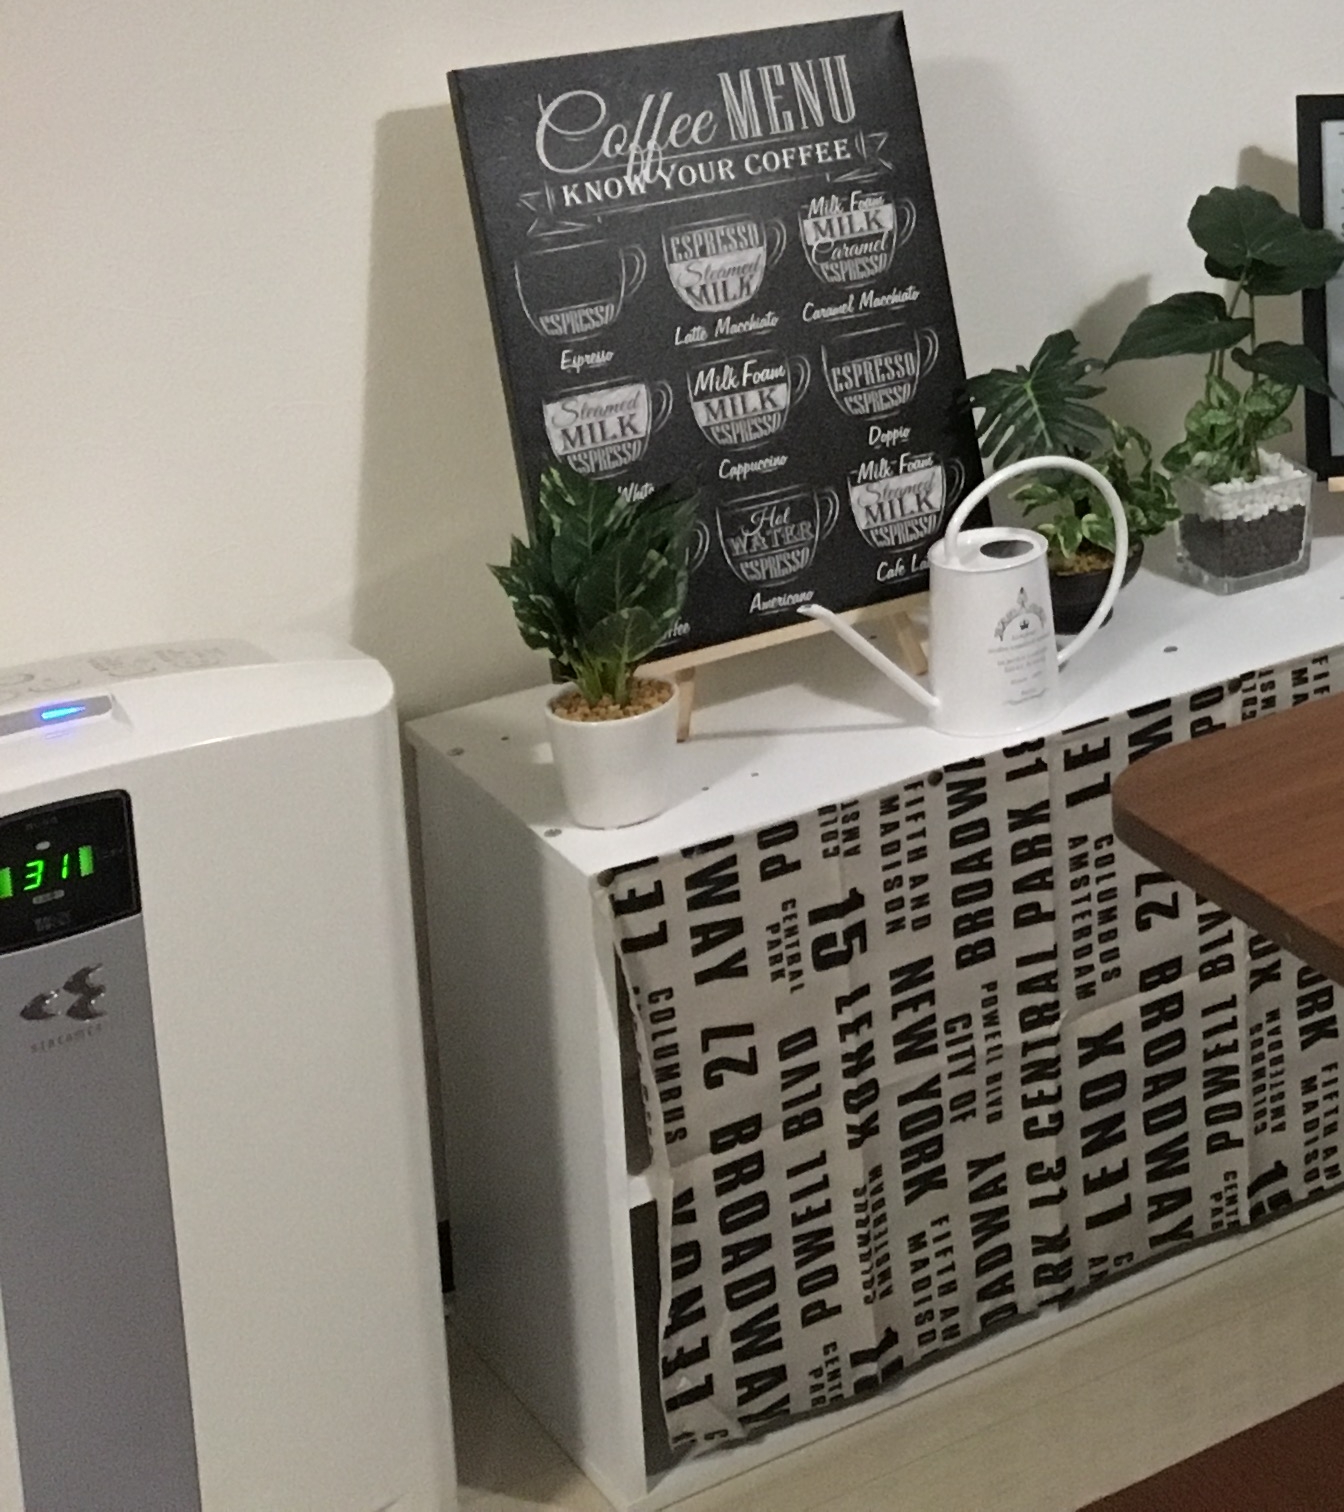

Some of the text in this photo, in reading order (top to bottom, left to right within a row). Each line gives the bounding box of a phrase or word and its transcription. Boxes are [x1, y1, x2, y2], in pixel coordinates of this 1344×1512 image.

[535, 54, 856, 182] Coffee MENU
[562, 138, 852, 207] KNOW YOUR COFFEE
[809, 194, 843, 218] Milk
[812, 209, 884, 239] MILK
[670, 222, 760, 262] ESPRESSO
[812, 230, 888, 265] Caramel
[820, 253, 888, 283] ESPRESSO
[539, 303, 614, 336] ESPRESSO
[802, 285, 920, 322] Caramel Macchiato
[675, 311, 779, 346] Latte Macchiato
[561, 349, 614, 373] Espresso
[694, 359, 786, 396] Milk Foam
[831, 351, 915, 393] ESPRESSO
[703, 390, 778, 423] MILK
[843, 383, 912, 415] ESPRESSO
[561, 413, 641, 452] MILK
[710, 412, 782, 445] ESPRESSO
[868, 425, 911, 446] Doppio
[567, 439, 642, 474] ESPRESSO
[719, 455, 788, 481] Cappuccino
[857, 458, 892, 484] Milk
[863, 493, 935, 527] MILK
[869, 514, 938, 548] ESPRESSO
[739, 546, 810, 582] ESPRESSO
[750, 590, 814, 614] Americano
[879, 794, 906, 936] MADISON
[903, 780, 932, 932] FIFTH AND
[1068, 834, 1096, 1001] AMSTERDAM
[1094, 833, 1122, 983] COLUMBUS
[1135, 871, 1180, 932] 27
[781, 897, 805, 994] CENTRAL
[808, 887, 868, 973] 15
[765, 921, 787, 983] PARK
[1007, 798, 1064, 1141] CENTRAL PARK
[648, 986, 688, 1146] COLUMBUS
[700, 1022, 759, 1091] 27
[834, 982, 880, 1150] LENOX
[943, 1012, 977, 1124] CITY OF
[981, 980, 1003, 1124] POWELL BLVD
[888, 954, 948, 1207] NEW YORK
[1200, 993, 1244, 1156] POWELL
[1139, 955, 1194, 1250] BROADWAY
[1077, 1021, 1132, 1231] LENOX
[777, 1026, 842, 1329] POWELL BLVD
[709, 1112, 791, 1425] BROADWAY
